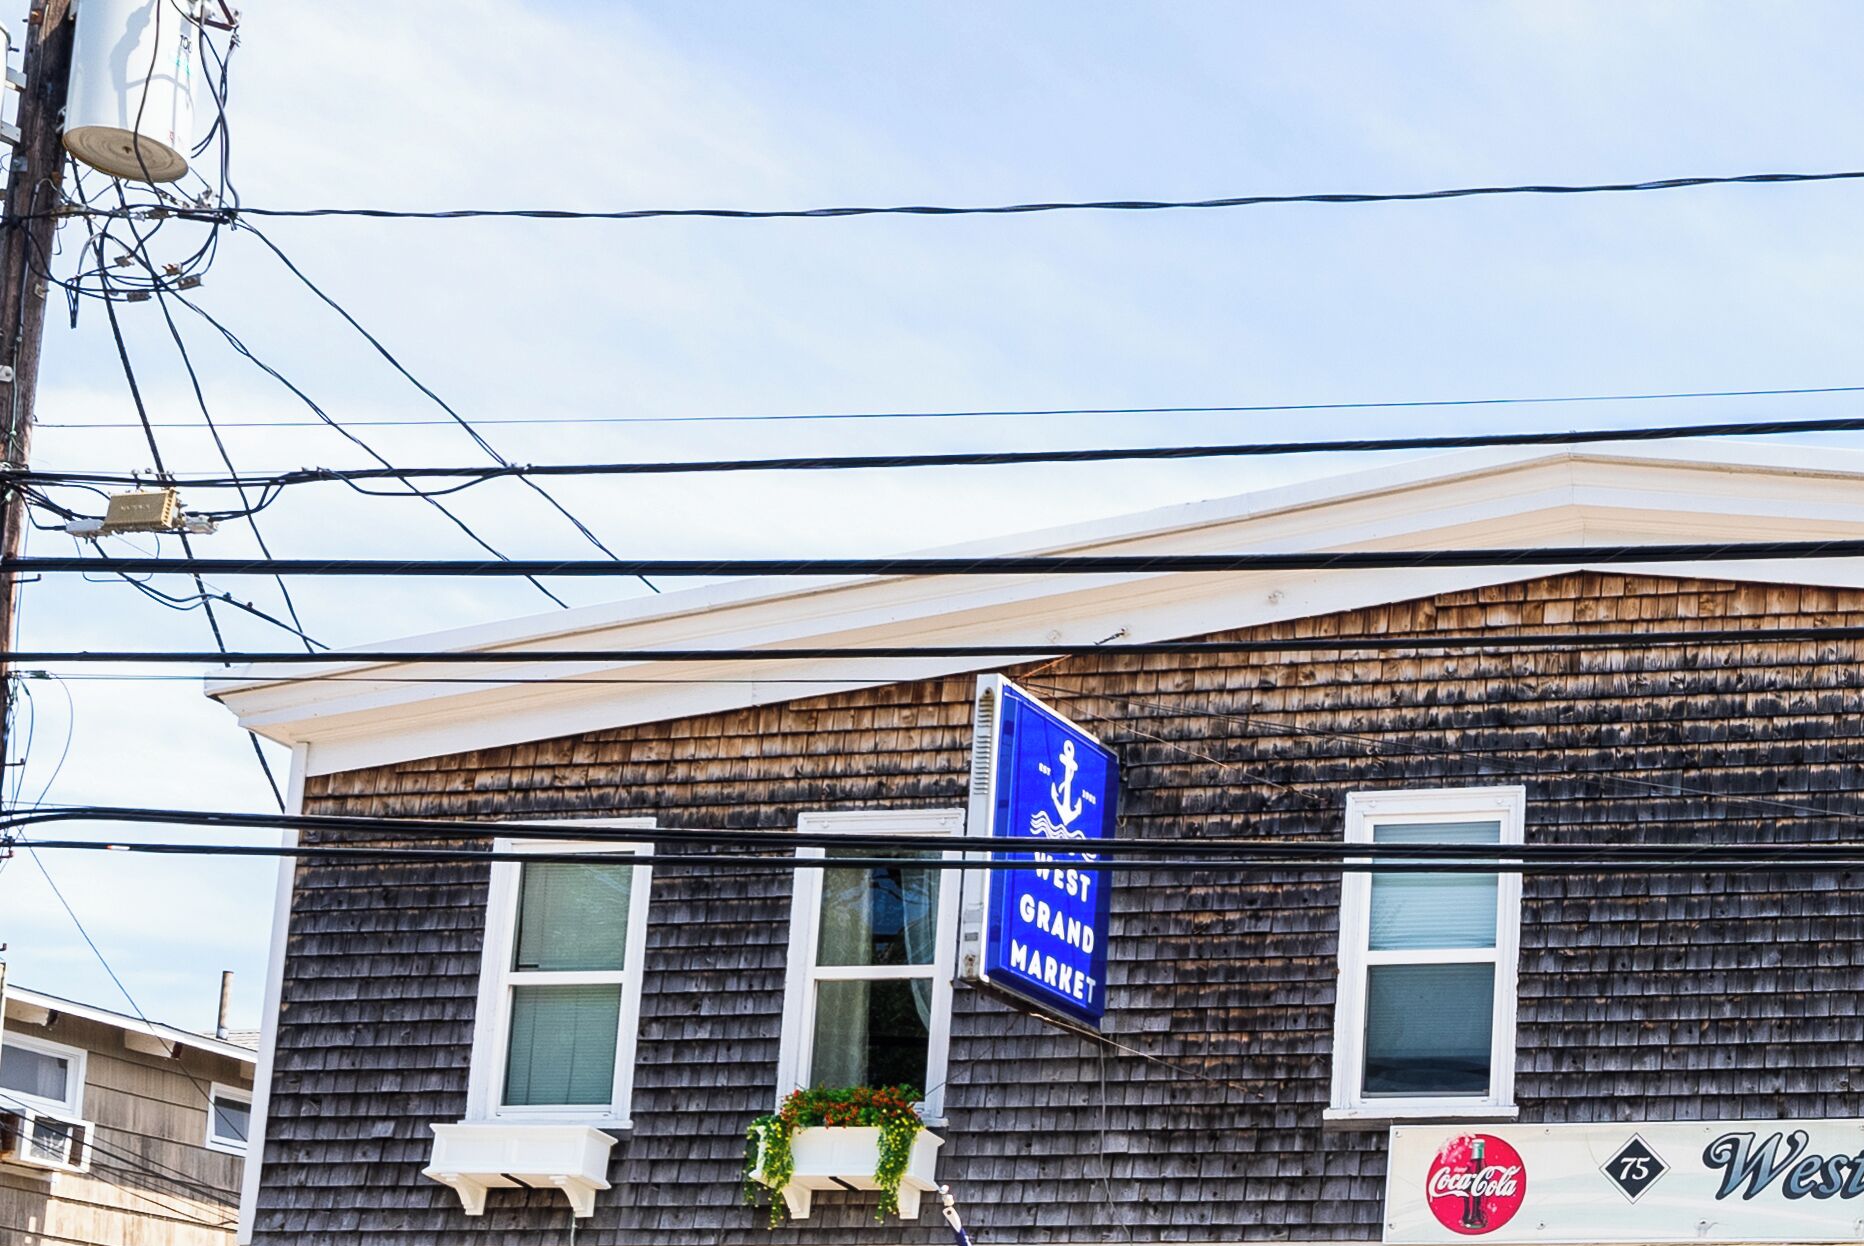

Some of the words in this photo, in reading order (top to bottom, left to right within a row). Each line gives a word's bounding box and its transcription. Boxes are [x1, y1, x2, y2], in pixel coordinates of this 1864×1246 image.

[1034, 851, 1091, 902] WEST
[1019, 893, 1095, 955] GRAND
[1010, 939, 1096, 1004] MARKET
[1428, 1165, 1521, 1202] Coca-Cola
[1619, 1156, 1650, 1180] 75
